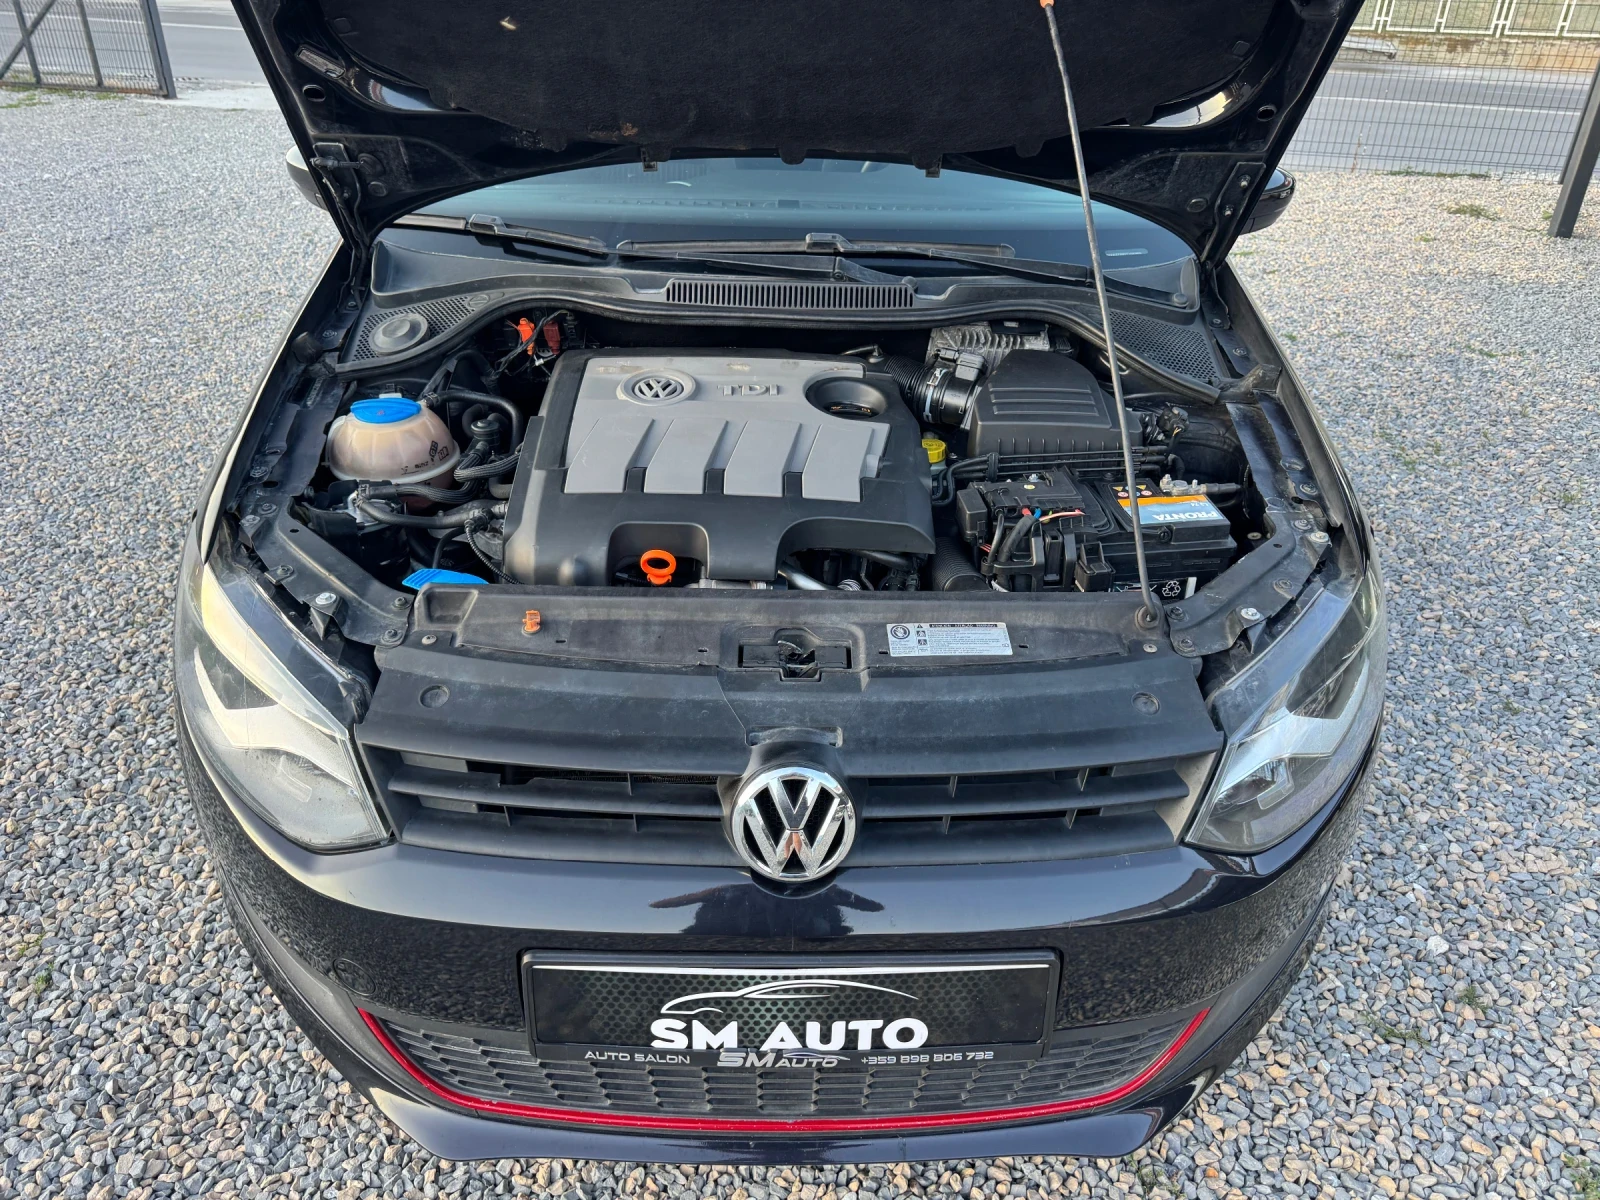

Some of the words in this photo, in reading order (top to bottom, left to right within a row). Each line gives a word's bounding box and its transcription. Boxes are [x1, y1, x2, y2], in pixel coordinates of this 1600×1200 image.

[717, 384, 779, 396] TDI
[1152, 511, 1218, 521] PRONTA
[650, 1018, 738, 1050] SM
[760, 1017, 929, 1051] AUTO
[584, 1050, 630, 1061] AUTO
[634, 1053, 690, 1064] SALON
[717, 1052, 776, 1068] SM
[775, 1056, 839, 1068] AUTO
[861, 1055, 896, 1065] +359
[899, 1055, 930, 1064] 898
[966, 1051, 994, 1061] 732
